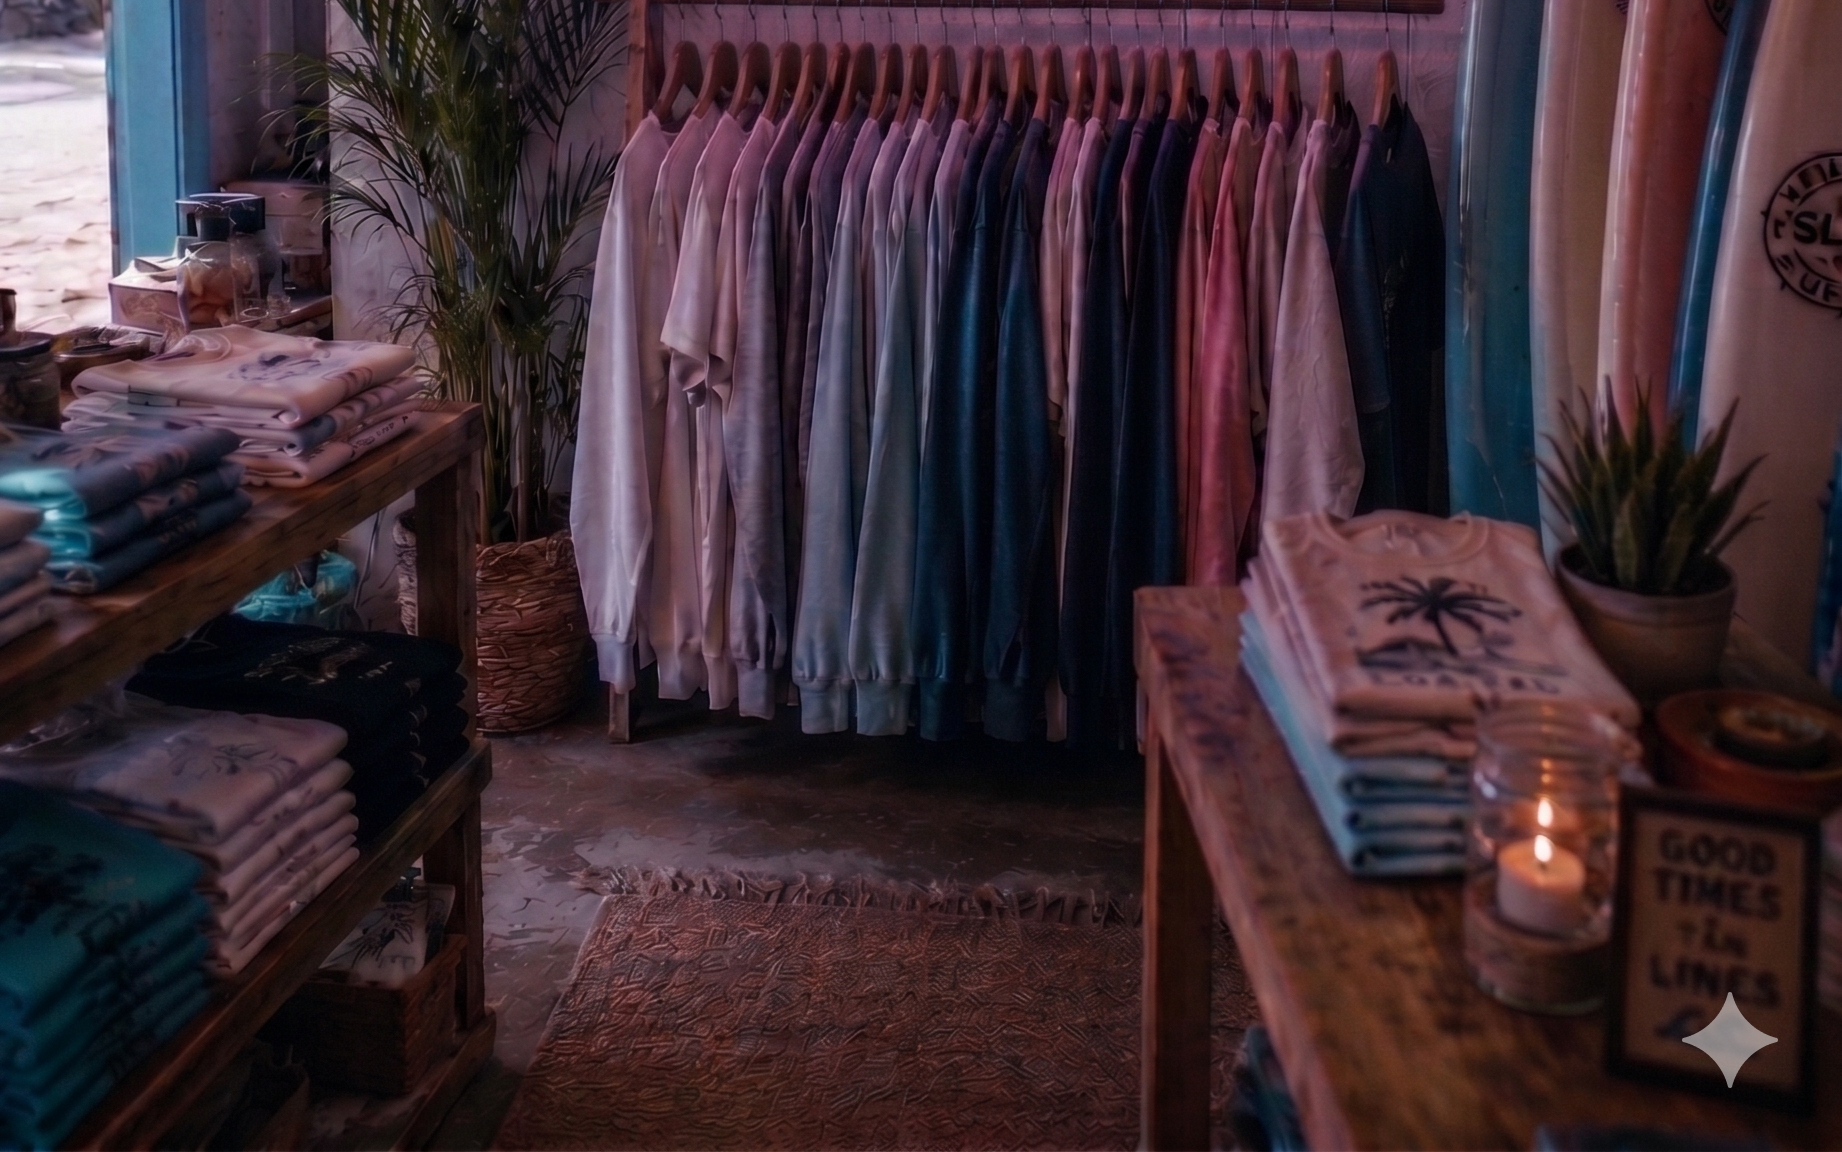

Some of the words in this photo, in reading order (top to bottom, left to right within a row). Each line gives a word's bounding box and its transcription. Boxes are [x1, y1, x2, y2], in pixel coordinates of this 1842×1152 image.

[1659, 828, 1776, 876] GOOD
[1653, 866, 1782, 921] TIMES
[1648, 953, 1782, 1010] LINES
